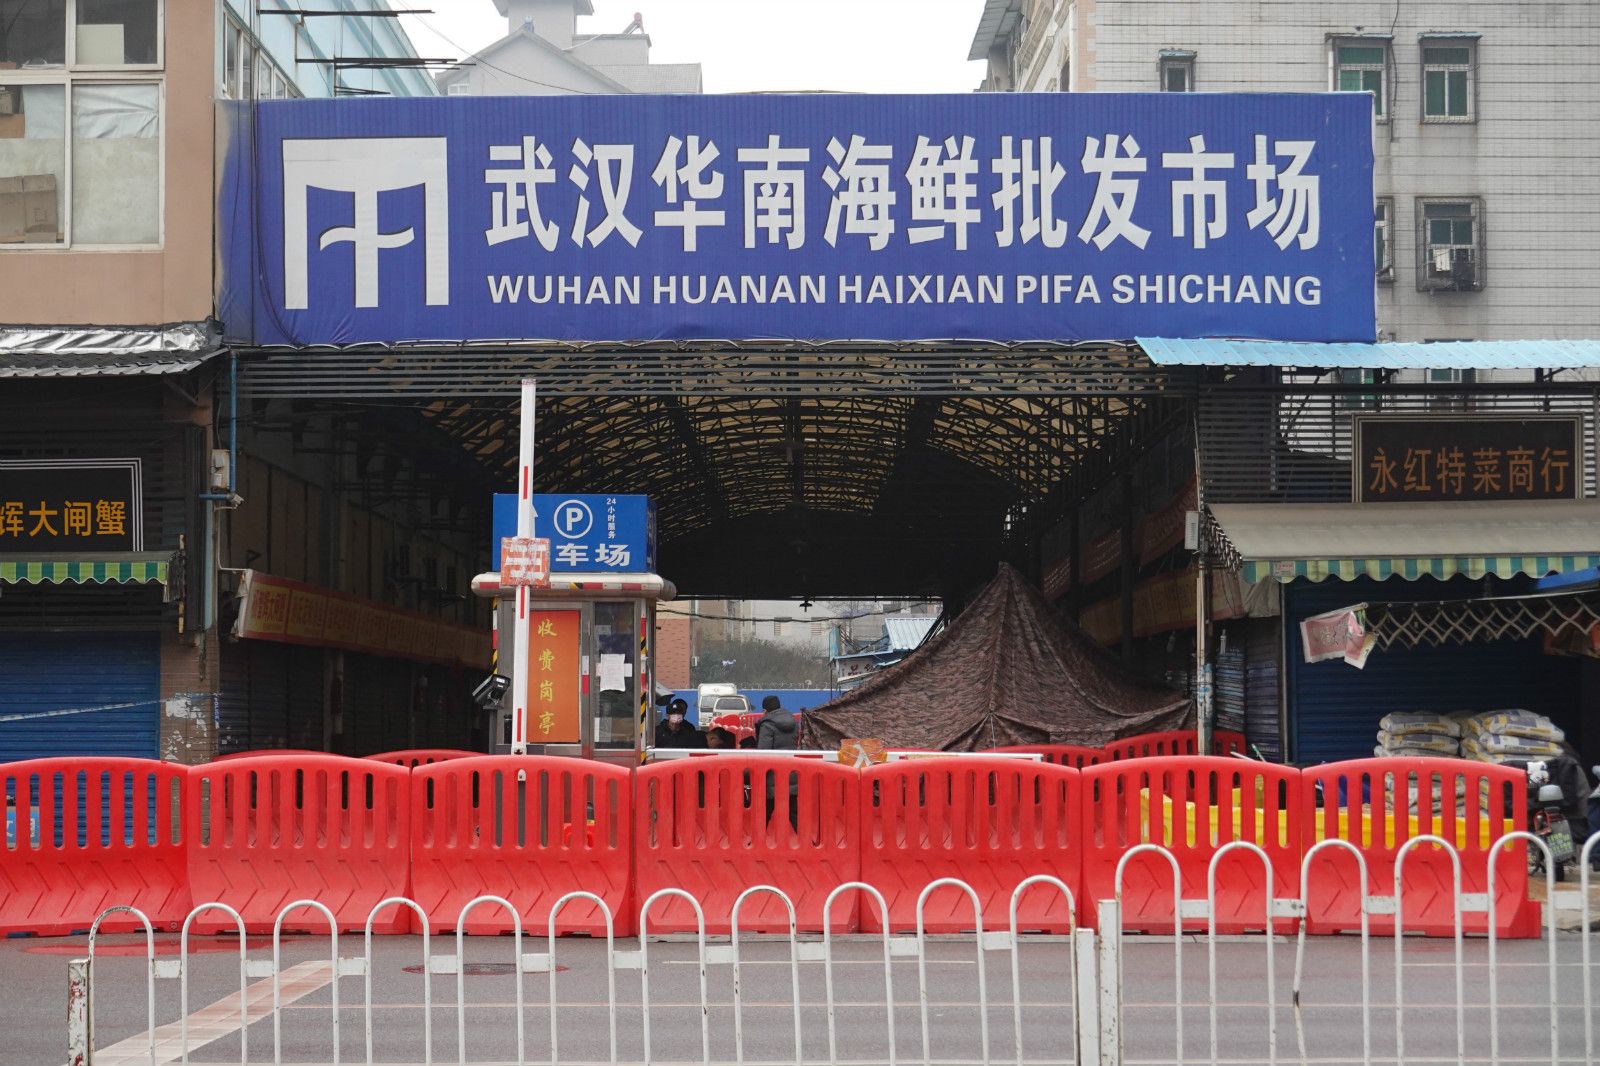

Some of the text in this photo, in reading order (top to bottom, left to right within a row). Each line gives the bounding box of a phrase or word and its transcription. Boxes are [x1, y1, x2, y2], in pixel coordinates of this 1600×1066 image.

[485, 133, 1321, 252] 武汉华南海鲜批发市场
[487, 274, 1322, 306] WUHAN HUANAN HAIXIAN PIFA SHICHANG
[1370, 447, 1569, 494] 永红特菜商行
[537, 618, 557, 735] 收费岗亭
